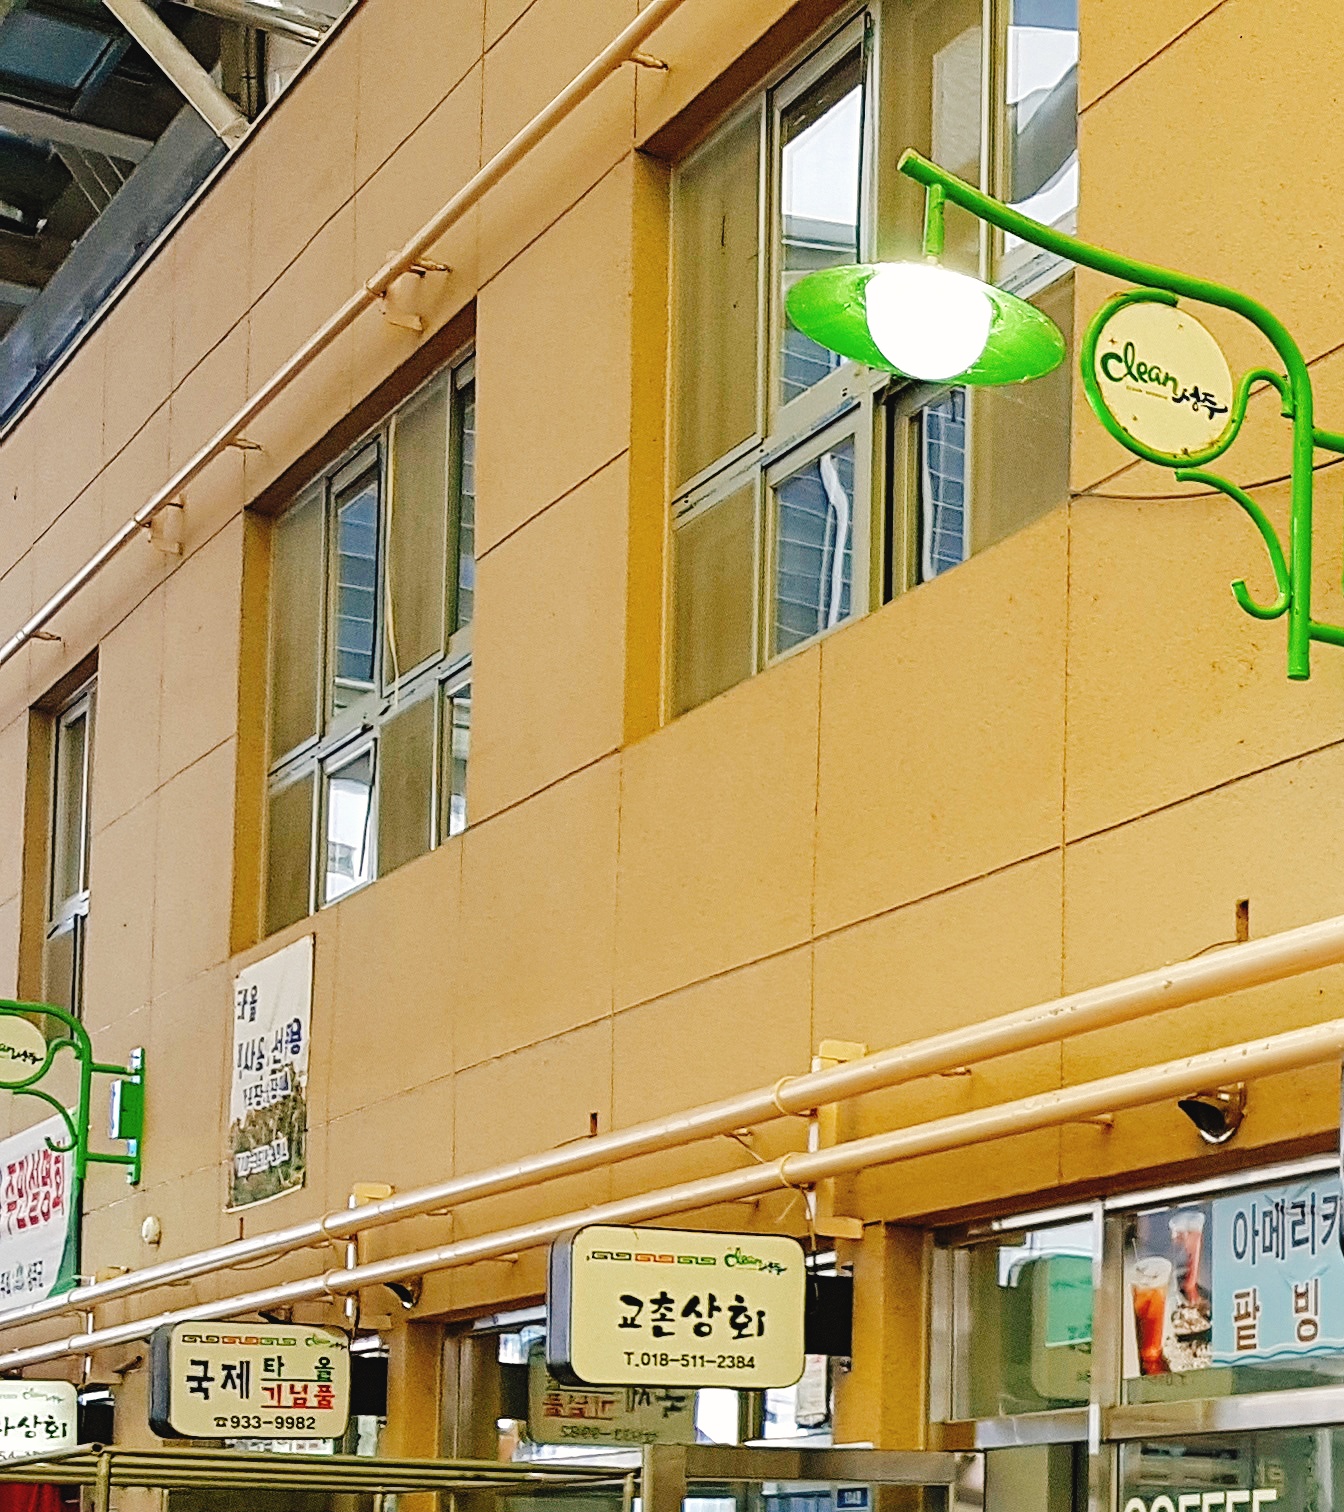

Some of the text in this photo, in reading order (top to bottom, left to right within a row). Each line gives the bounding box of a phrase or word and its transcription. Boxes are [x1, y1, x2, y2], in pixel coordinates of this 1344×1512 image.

[618, 1291, 766, 1340] 교촌상회
[624, 1352, 756, 1370] T.018-511-2384
[186, 1358, 250, 1400] 국제
[230, 1416, 316, 1430] 933-9982
